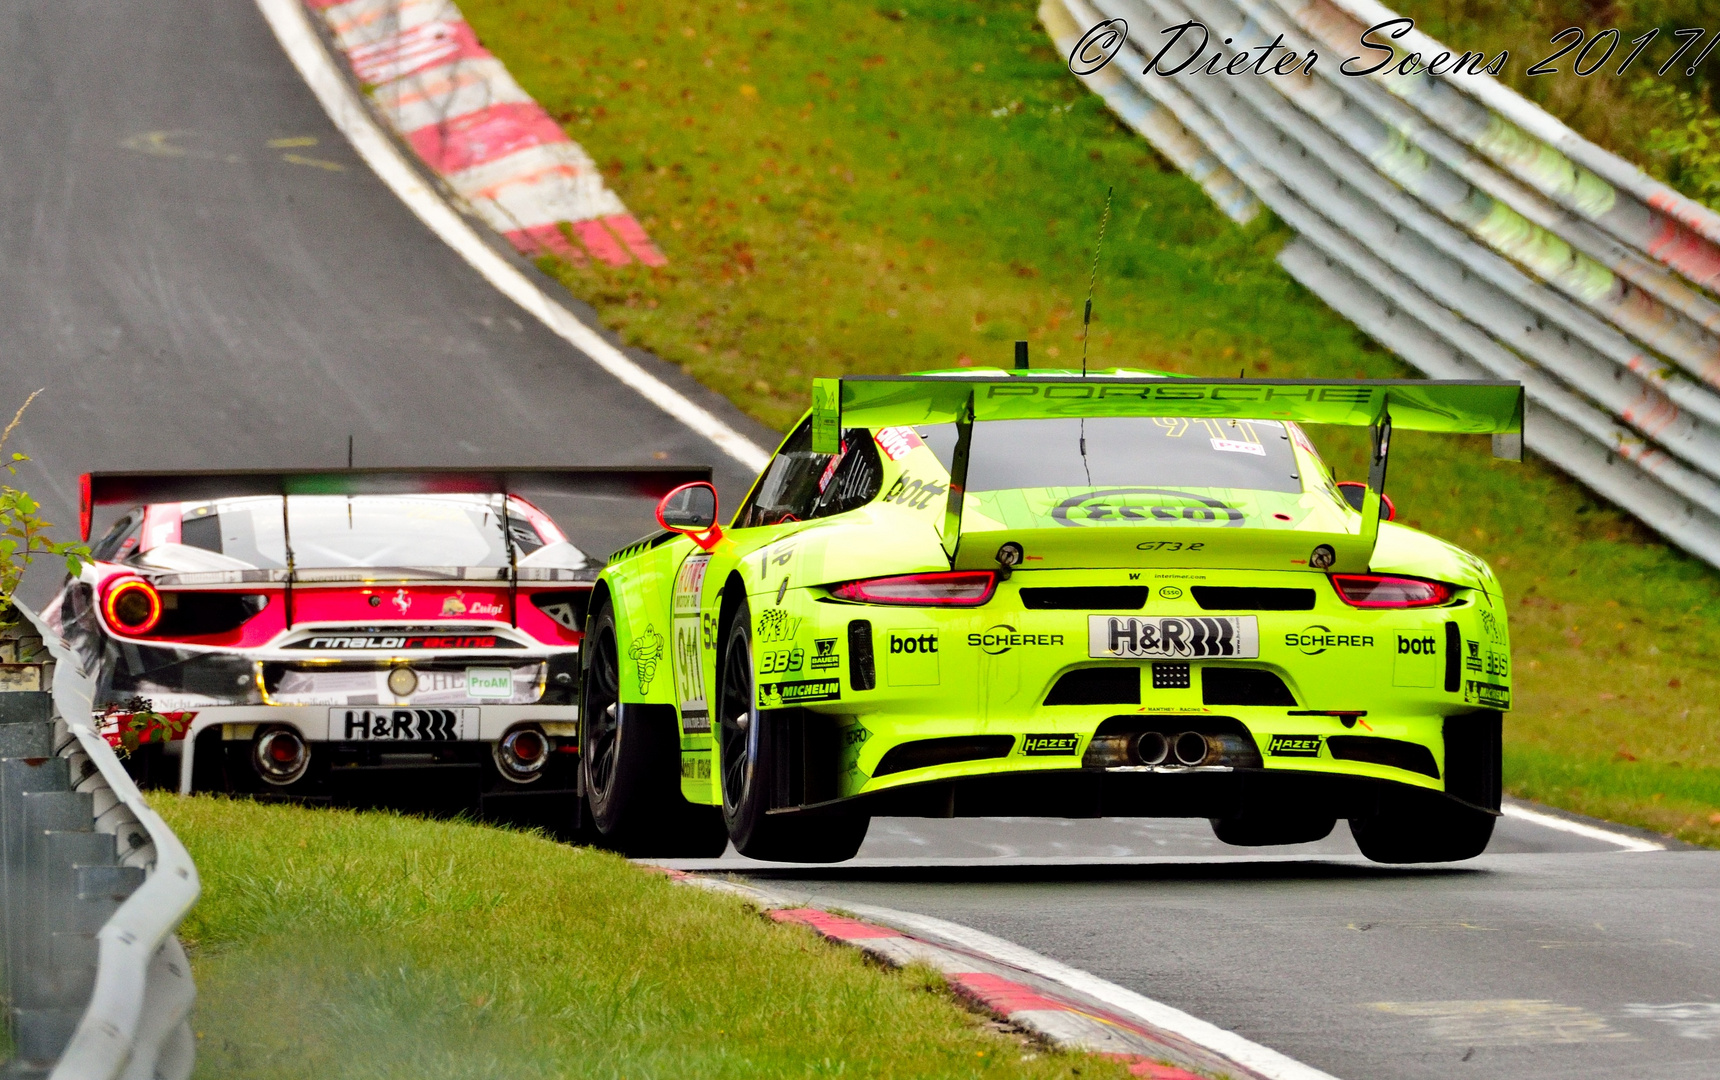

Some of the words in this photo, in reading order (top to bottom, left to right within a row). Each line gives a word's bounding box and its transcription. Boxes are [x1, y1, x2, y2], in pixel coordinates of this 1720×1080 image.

[987, 385, 1373, 403] PORSCHE
[883, 469, 948, 510] bott
[1136, 541, 1182, 551] GT3
[469, 602, 503, 616] Luigi
[890, 634, 938, 654] bott
[967, 633, 1064, 646] SCHERER
[1108, 616, 1192, 657] H&R
[1285, 633, 1374, 647] SCHERER
[1397, 635, 1436, 655] bott
[679, 627, 703, 701] 911
[759, 648, 804, 674] BBS
[811, 656, 839, 664] BAUER
[1486, 651, 1508, 677] BBS
[471, 677, 508, 689] ProAM
[782, 682, 839, 698] MICHELIN
[344, 710, 418, 740] H&R
[1024, 738, 1077, 751] HAZET
[1270, 738, 1320, 751] HAZET
